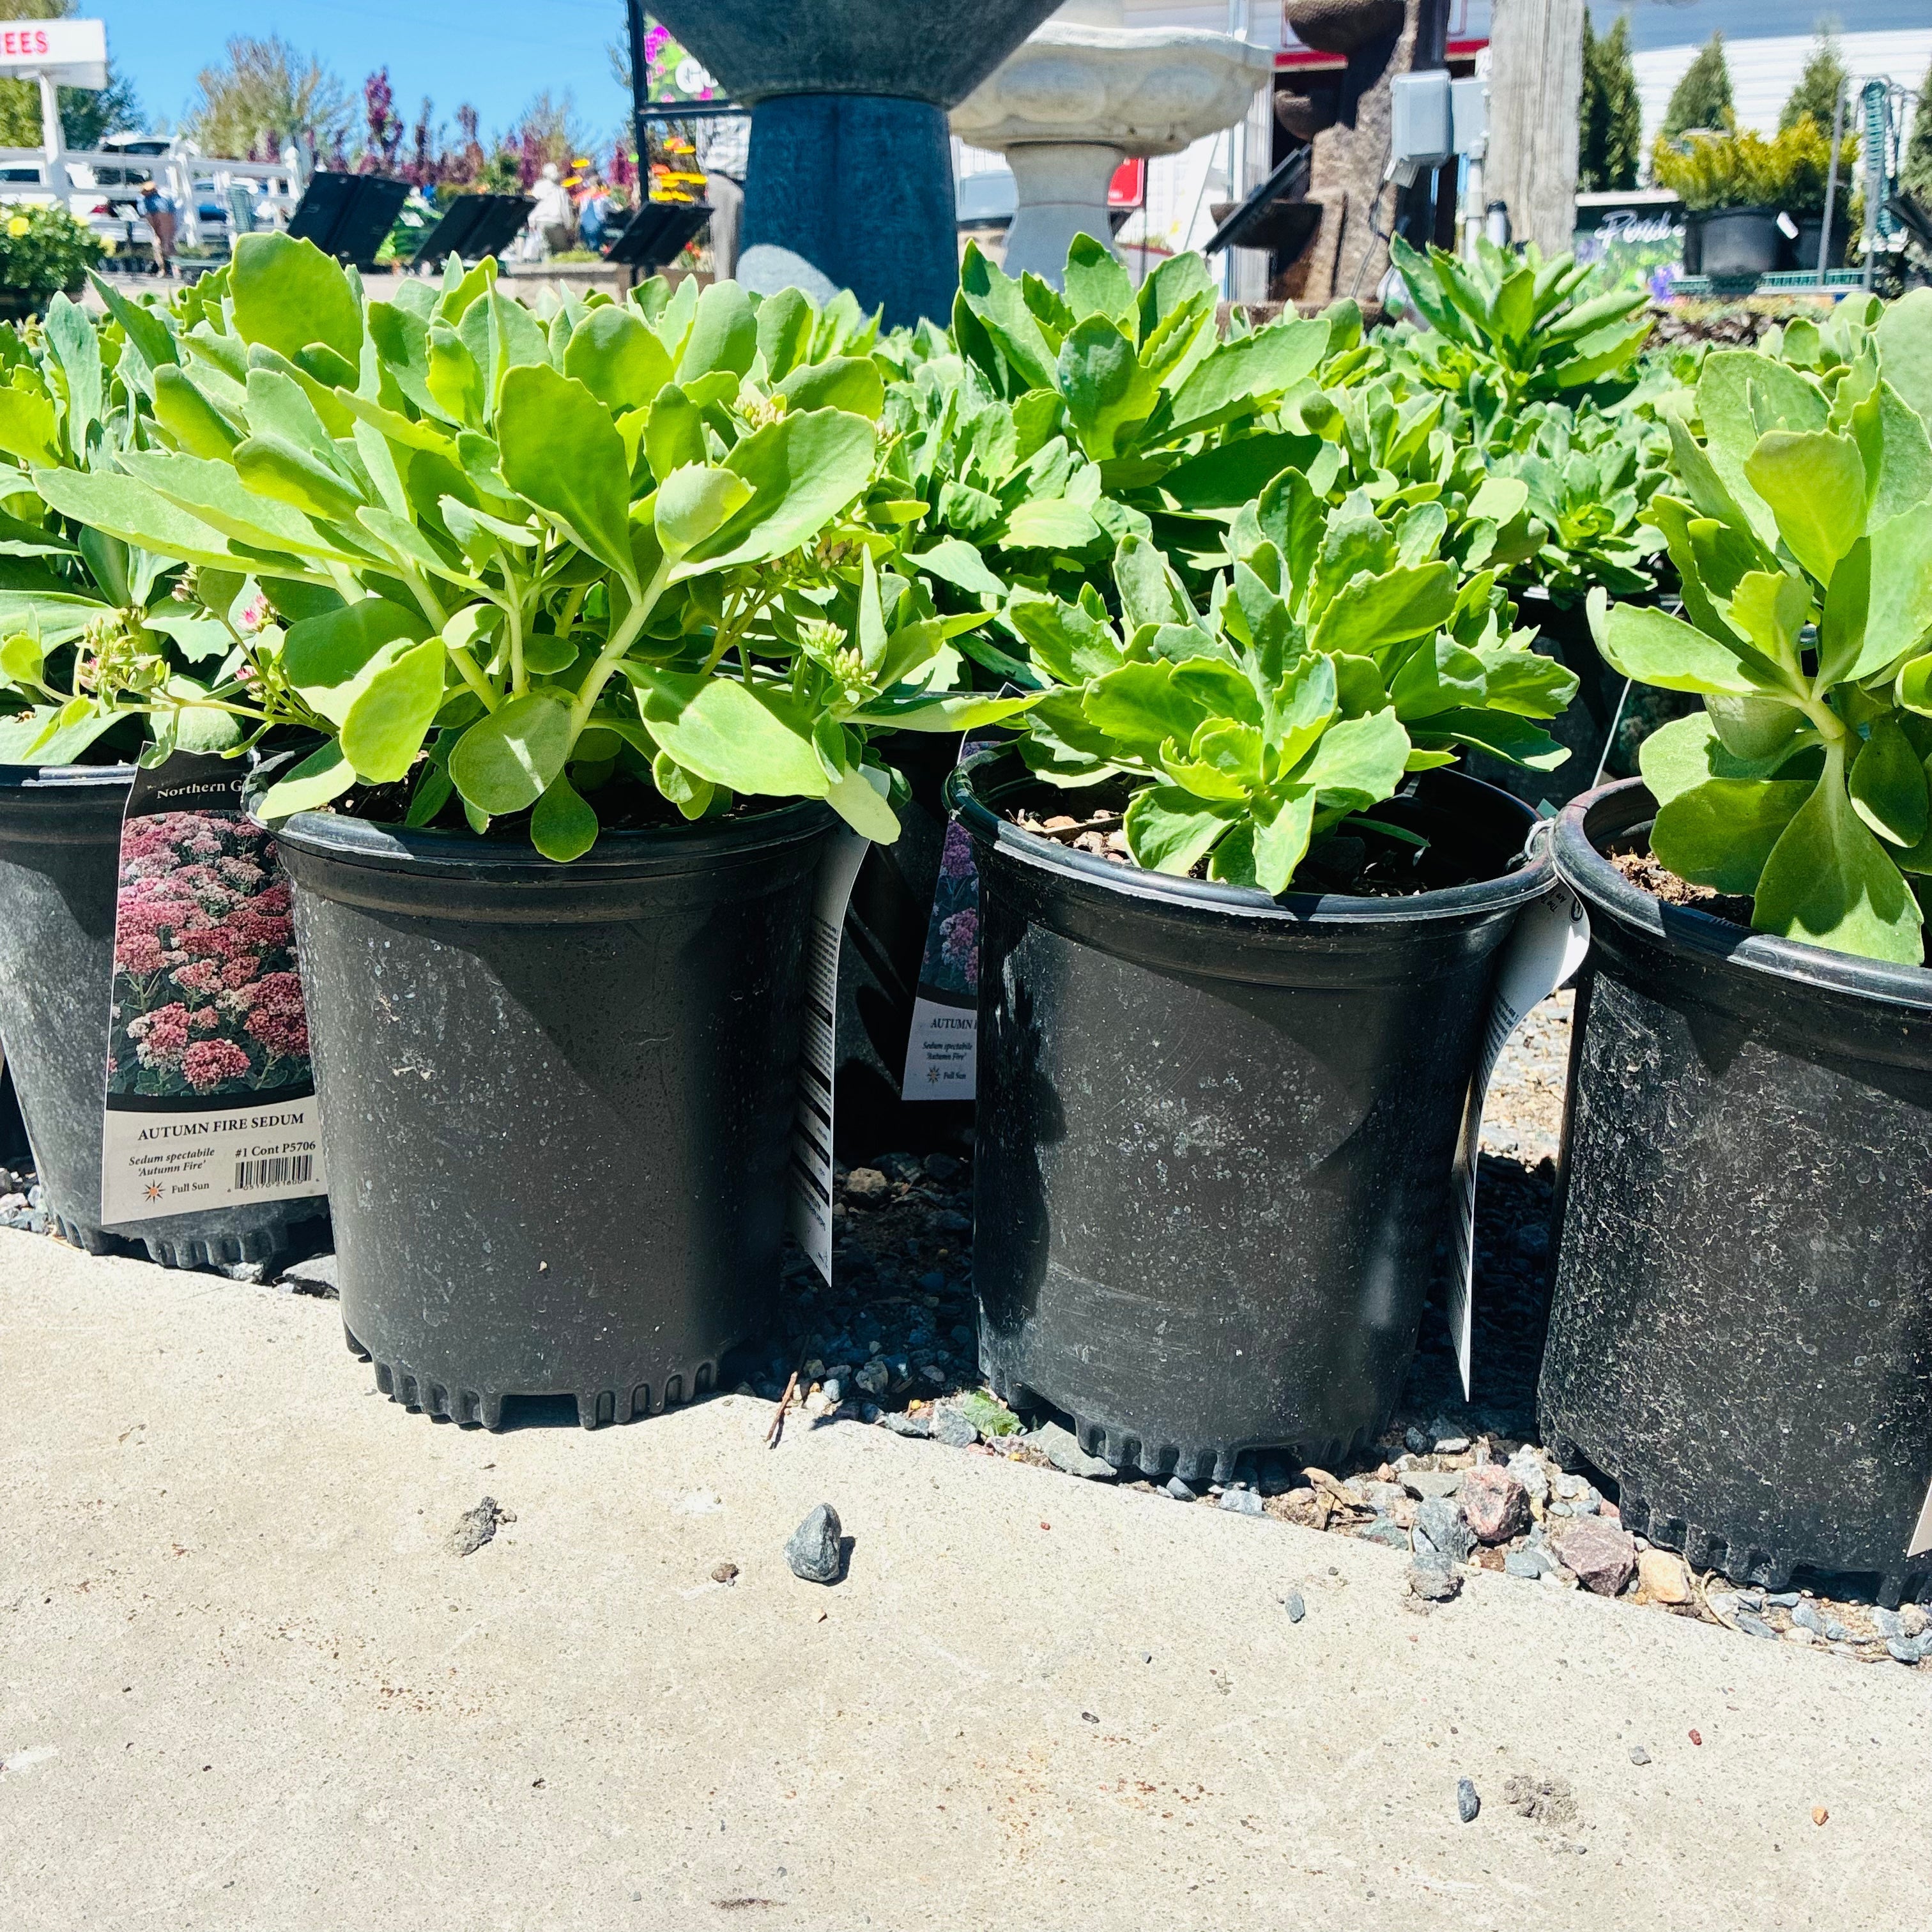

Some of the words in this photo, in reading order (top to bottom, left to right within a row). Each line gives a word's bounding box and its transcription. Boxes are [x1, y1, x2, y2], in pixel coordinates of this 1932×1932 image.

[0, 31, 49, 54] EES
[157, 783, 226, 799] Northern
[231, 779, 242, 792] G
[930, 1018, 972, 1029] AUTUMN
[137, 1122, 210, 1141] AUTUMN
[213, 1118, 247, 1132] FIRE
[250, 1112, 304, 1128] SEDUM
[128, 1154, 164, 1166] Sedum
[165, 1147, 215, 1163] spectabile
[234, 1147, 247, 1158] #1
[251, 1145, 279, 1156] Cont
[282, 1140, 316, 1153] P5706
[171, 1183, 190, 1194] Full
[192, 1181, 210, 1192] Sun
